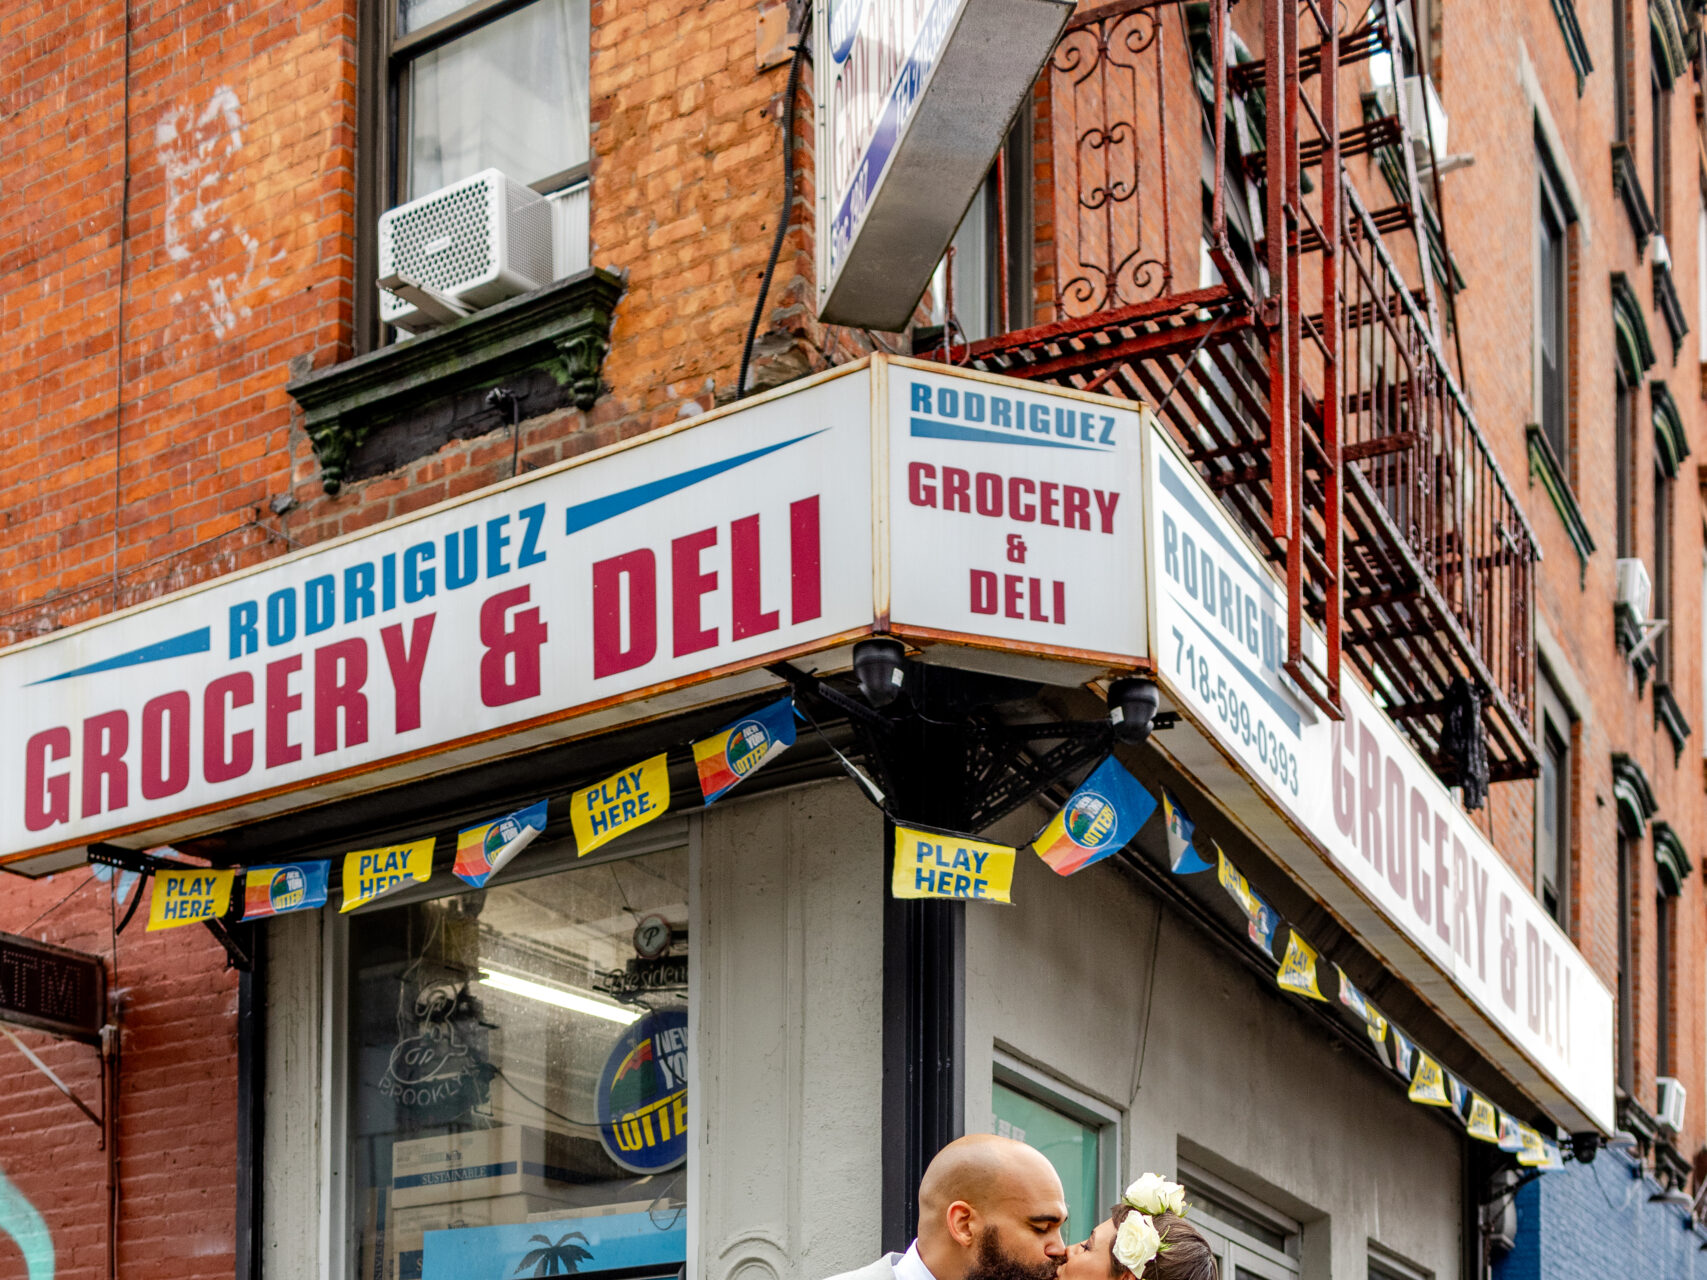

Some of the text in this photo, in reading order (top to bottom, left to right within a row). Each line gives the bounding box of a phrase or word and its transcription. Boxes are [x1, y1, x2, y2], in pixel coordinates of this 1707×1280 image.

[910, 382, 1116, 446] RODRIGUEZ
[908, 460, 1120, 535] GROCERY
[1006, 533, 1027, 565] &
[228, 502, 547, 660] RODRIGUEZ
[970, 567, 1066, 625] DELI
[1162, 510, 1299, 691] RODRIGUE
[25, 493, 822, 832] GROCERY & DELI
[1172, 625, 1299, 798] 718-599-0393
[586, 767, 644, 811] PLAY
[590, 791, 657, 836] HERE.
[1080, 803, 1115, 847] LOTTERY
[359, 848, 413, 876] PLAY
[916, 842, 990, 874] PLAY
[166, 876, 218, 897] PLAY
[1331, 695, 1572, 1070] GROCERY & DELI
[164, 899, 217, 920] HERE.
[1288, 947, 1309, 972] PLAY
[0, 950, 81, 1018] TM
[421, 1167, 487, 1185] SUSTAINABLE
